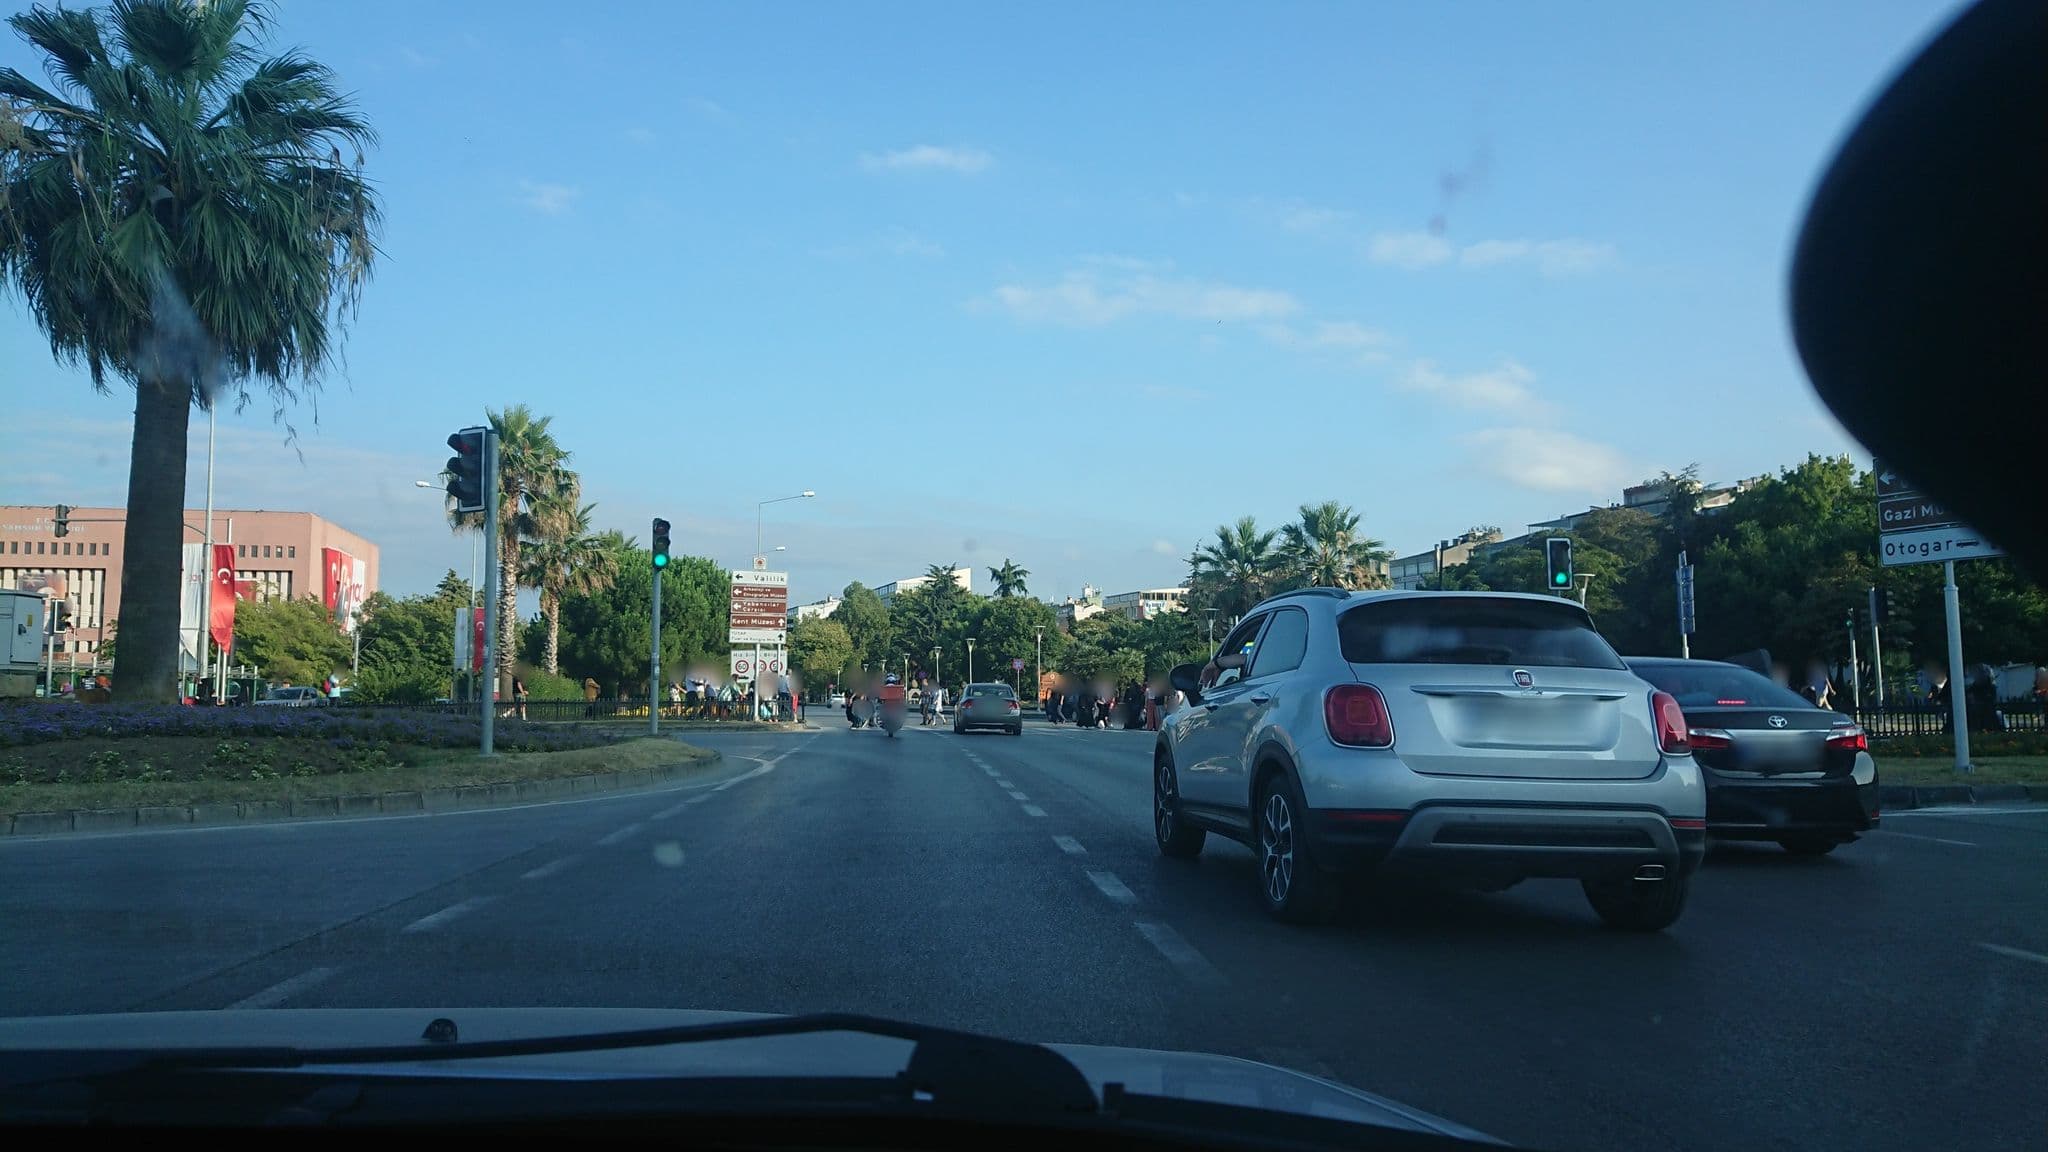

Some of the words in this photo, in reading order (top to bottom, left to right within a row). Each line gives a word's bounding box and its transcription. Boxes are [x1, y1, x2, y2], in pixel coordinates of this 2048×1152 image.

[1884, 505, 1917, 522] Gazi
[1885, 540, 1953, 557] Otogar
[754, 574, 785, 583] Valilik
